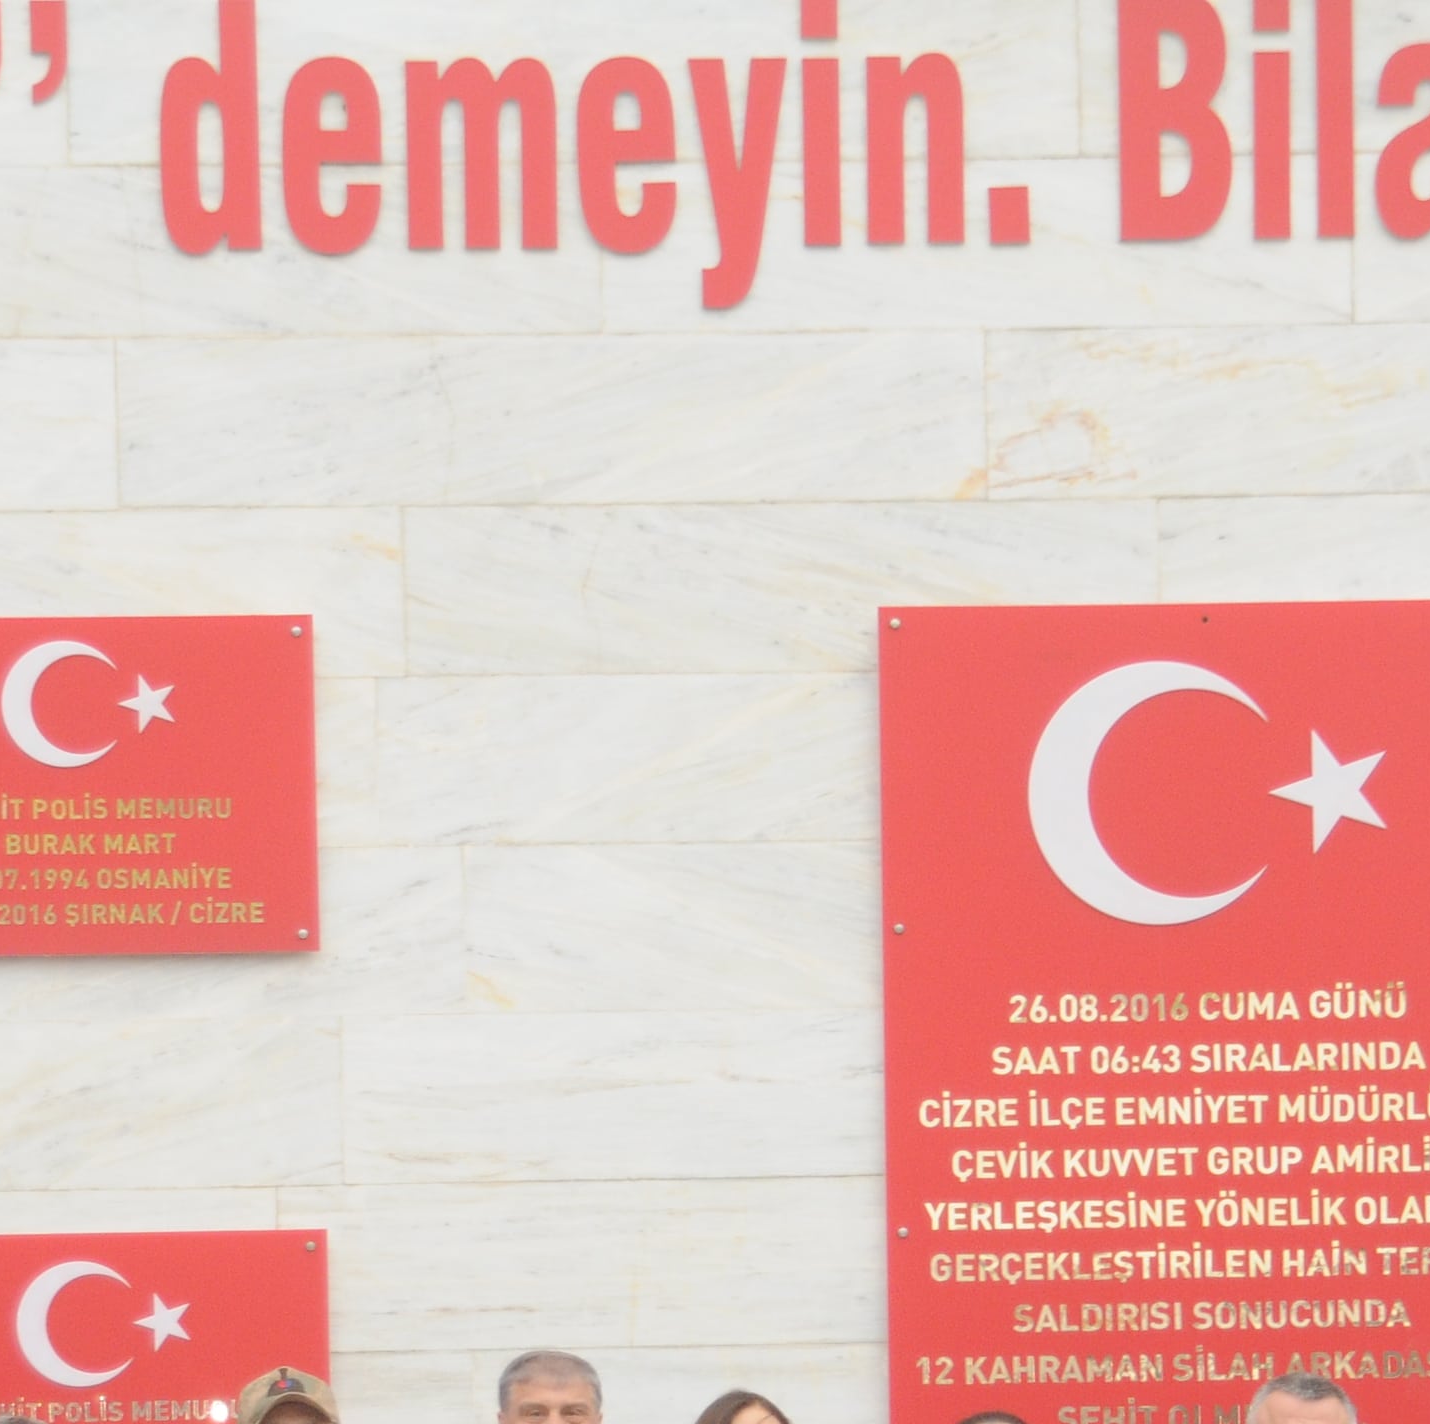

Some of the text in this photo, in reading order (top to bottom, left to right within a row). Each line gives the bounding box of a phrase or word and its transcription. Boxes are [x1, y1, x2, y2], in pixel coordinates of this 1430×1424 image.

[159, 0, 1031, 311] demeyin.
[31, 792, 109, 820] POLİS
[116, 797, 232, 819] MEMURU
[5, 832, 176, 855] BURAK MART
[96, 863, 232, 889] OSMANİYE
[64, 903, 164, 927] ŞIRNAK
[168, 900, 183, 925] /
[189, 896, 265, 924] CİZRE
[1009, 981, 1408, 1024] 26.08.2016 CUMA GÜNÜ
[992, 1041, 1427, 1075] SAAT 06:43 SIRALARINDA
[919, 1090, 1019, 1128] CİZRE
[1029, 1089, 1106, 1130] İLÇE
[1115, 1087, 1270, 1126] EMNİYET
[952, 1141, 1055, 1182] ÇEVİK
[1063, 1146, 1199, 1178] KUVVET
[1207, 1145, 1304, 1175] GRUP
[924, 1191, 1187, 1233] YERLEŞKESİNE
[1195, 1188, 1347, 1228] YÖNELİK
[930, 1241, 1273, 1285] GERÇEKLEŞTİRİLEN
[1282, 1239, 1368, 1278] HAİN
[1014, 1298, 1412, 1333] SALDIRISI SONUCUNDA
[917, 1356, 954, 1386] 12
[965, 1353, 1164, 1385] KAHRAMAN
[1173, 1344, 1274, 1383] SİLAH
[48, 1395, 123, 1424] POLİS
[131, 1400, 238, 1422] MEMUU
